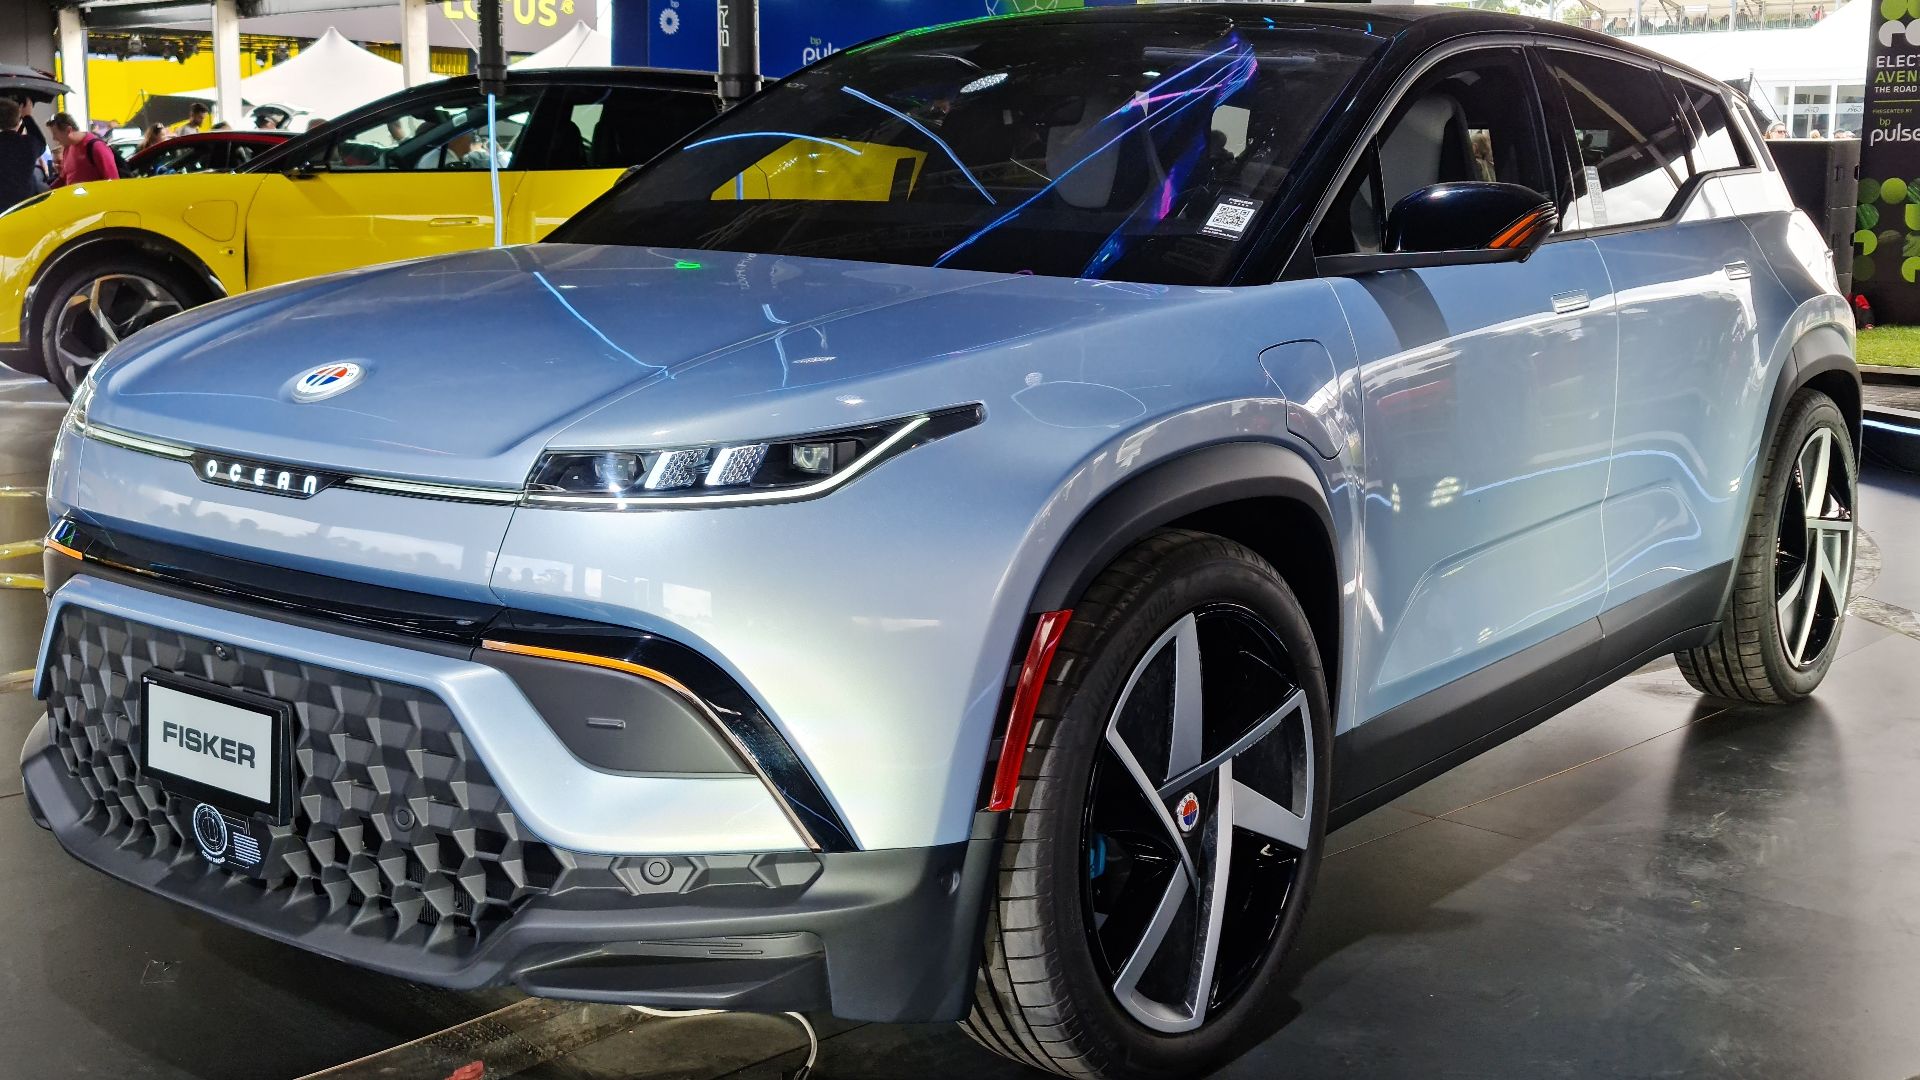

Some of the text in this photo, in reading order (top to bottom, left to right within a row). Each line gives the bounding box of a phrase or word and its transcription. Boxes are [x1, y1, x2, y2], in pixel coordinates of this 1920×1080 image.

[443, 0, 558, 27] LUS
[802, 42, 841, 66] pul
[1874, 70, 1920, 83] AVEN
[1893, 85, 1918, 93] ROAD
[1879, 117, 1891, 126] bp
[1870, 122, 1920, 146] pulse
[206, 459, 317, 495] OCEAN
[162, 720, 256, 769] FISKER
